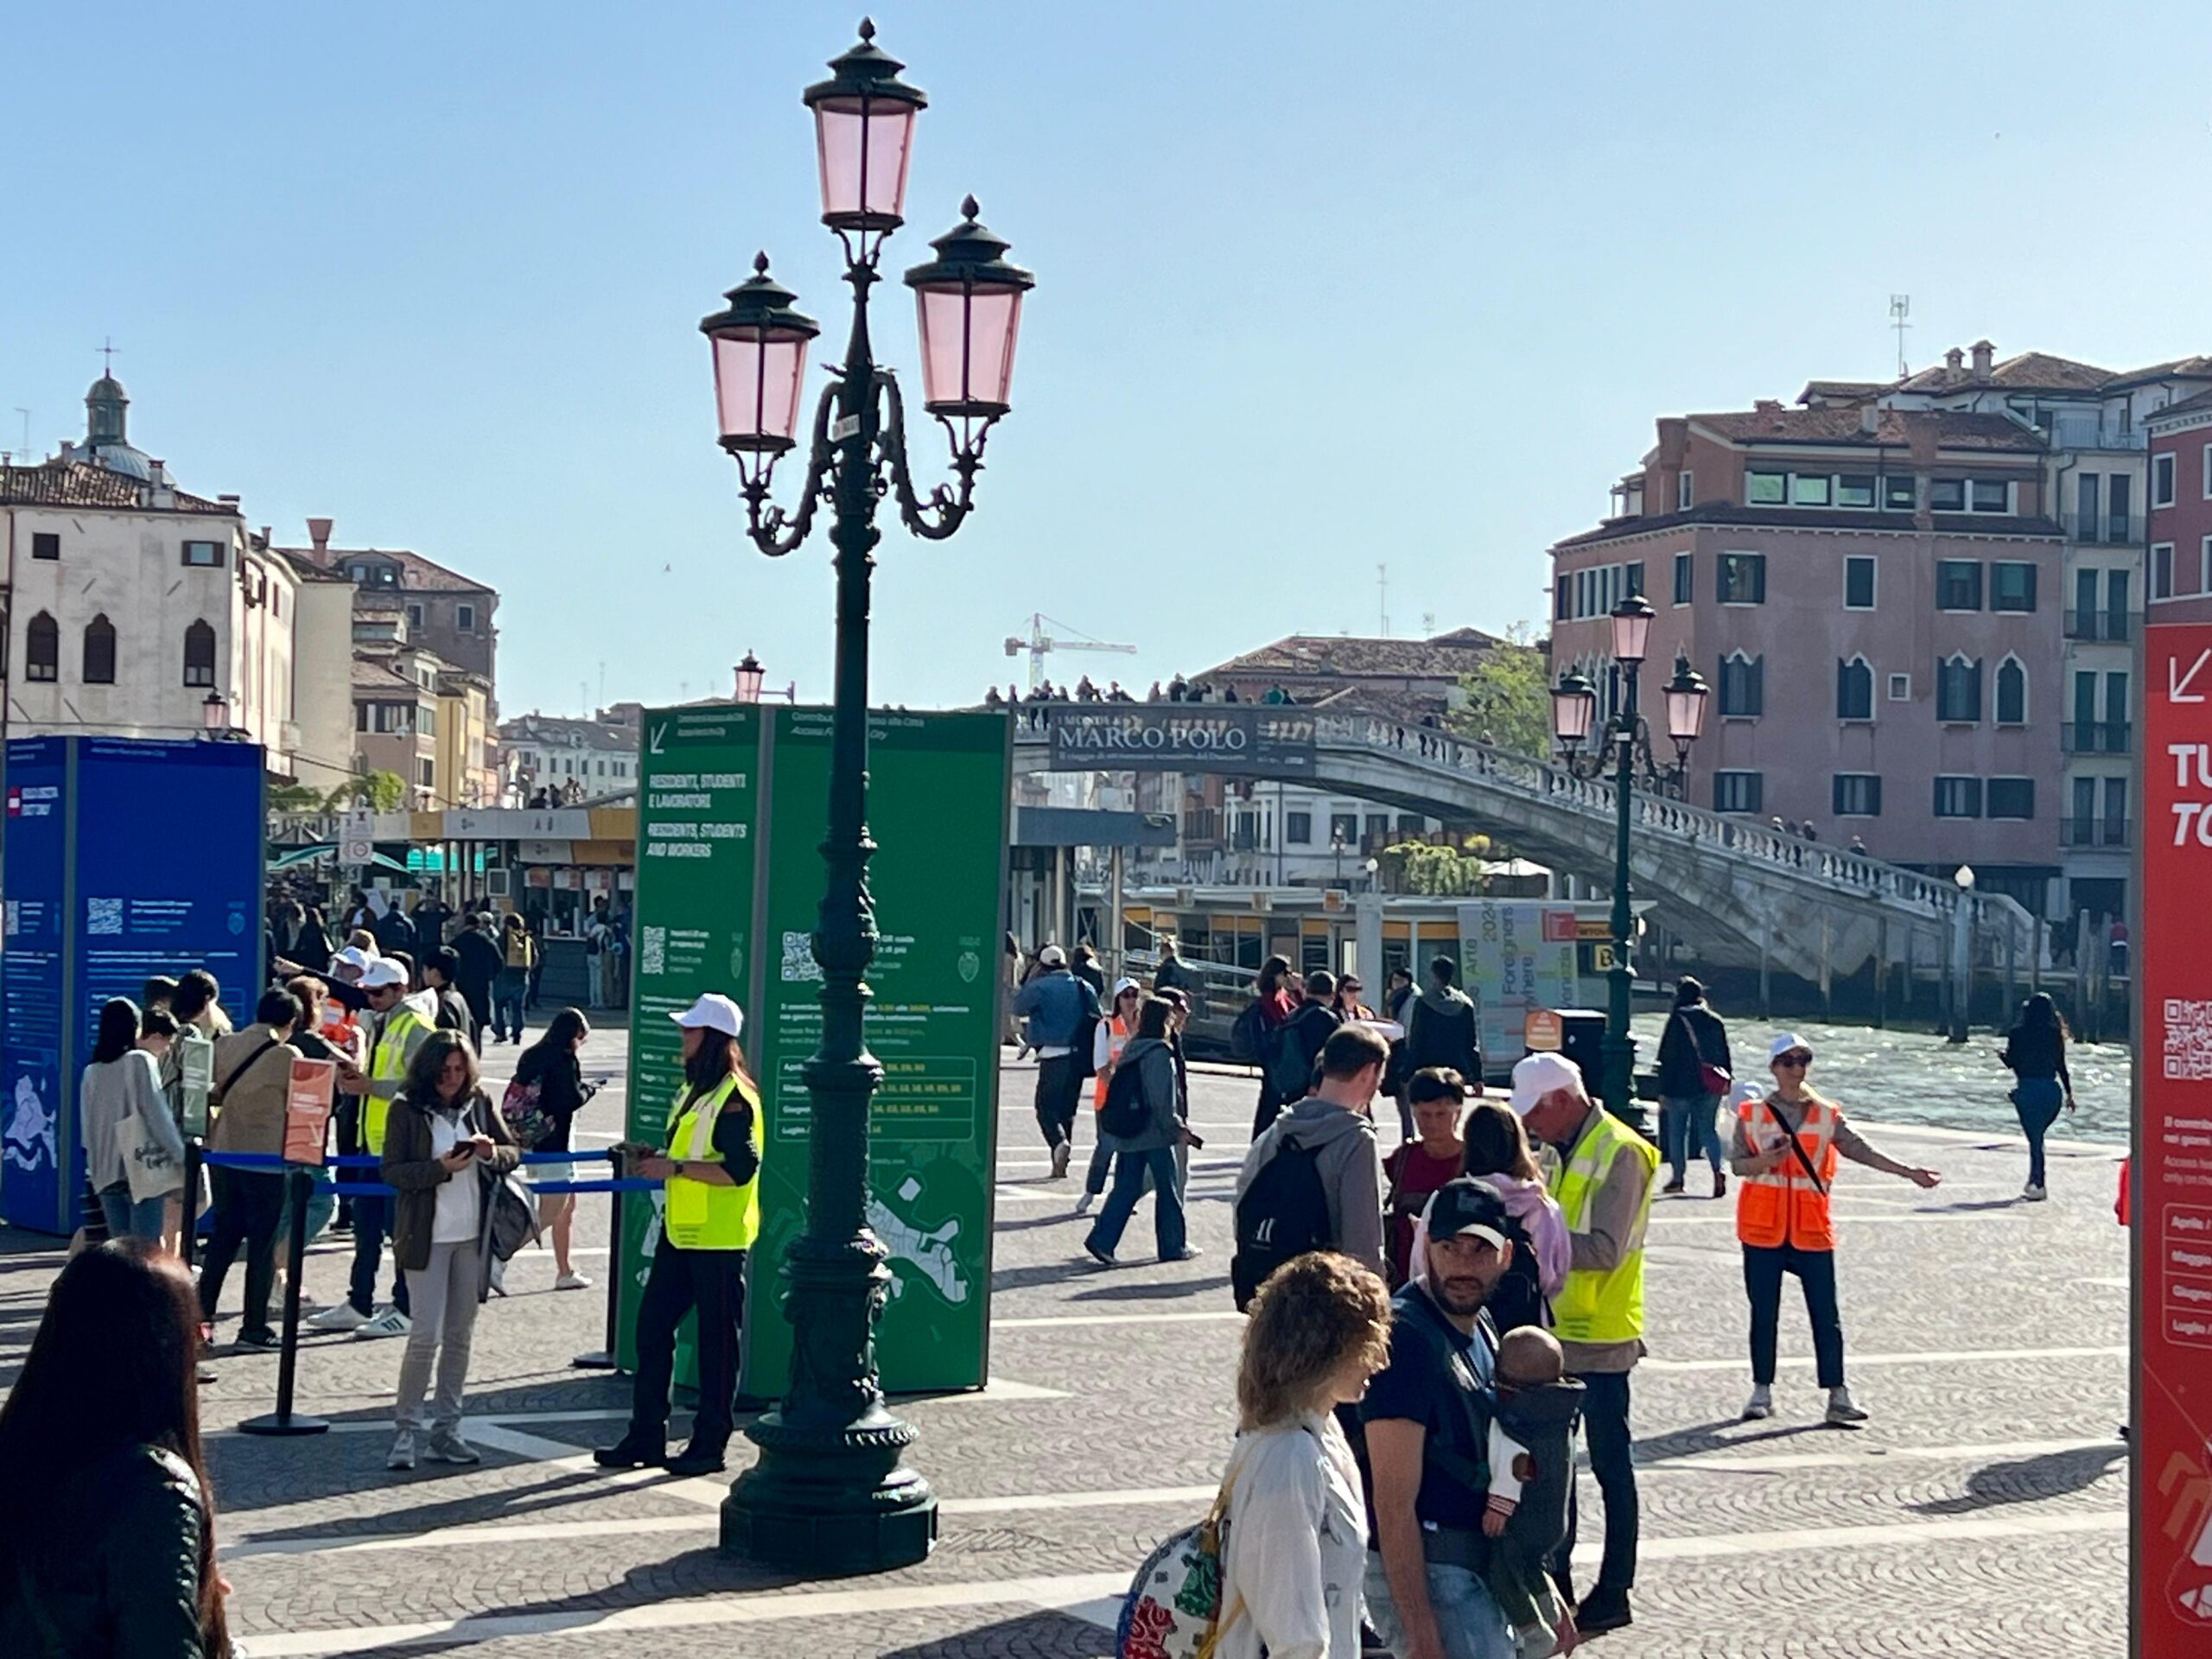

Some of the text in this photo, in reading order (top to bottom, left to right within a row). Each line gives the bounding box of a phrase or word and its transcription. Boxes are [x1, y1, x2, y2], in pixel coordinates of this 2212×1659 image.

[1058, 727, 1165, 748] MARCO
[1171, 727, 1247, 750] POLO
[1482, 902, 1497, 944] 2024
[1465, 938, 1478, 976] Arte
[1599, 948, 1614, 967] B
